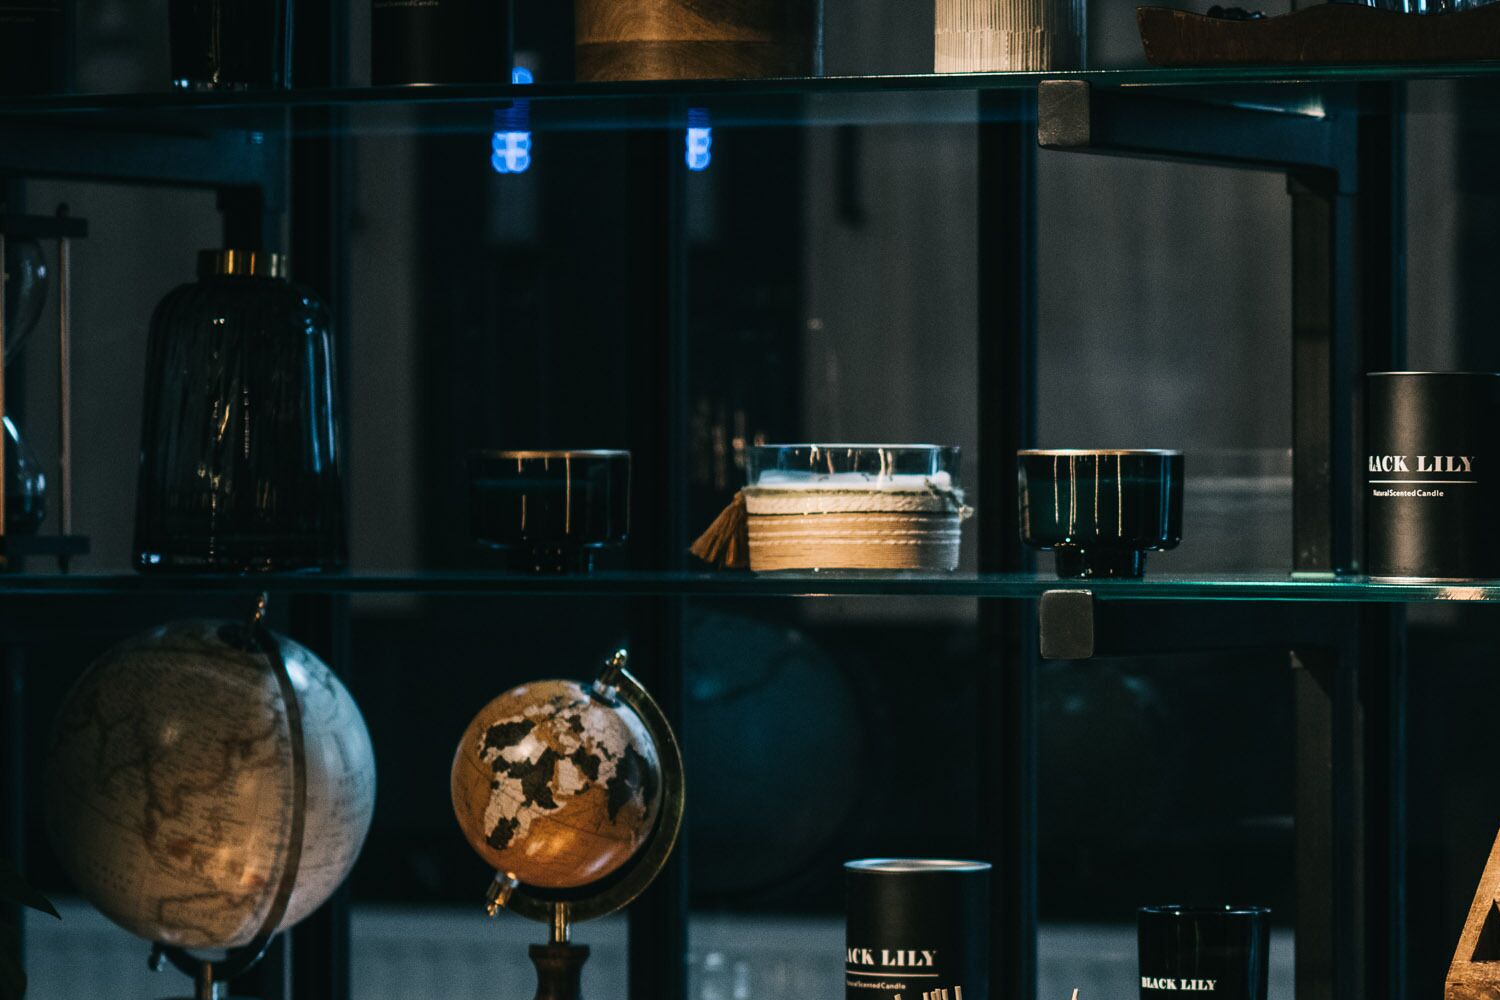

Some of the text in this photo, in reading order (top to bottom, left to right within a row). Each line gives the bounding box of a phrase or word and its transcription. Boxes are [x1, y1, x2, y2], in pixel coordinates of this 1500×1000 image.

[1368, 455, 1476, 472] LACK LILY
[846, 947, 938, 967] ACK LILY
[1141, 975, 1217, 991] BLACK LILY
